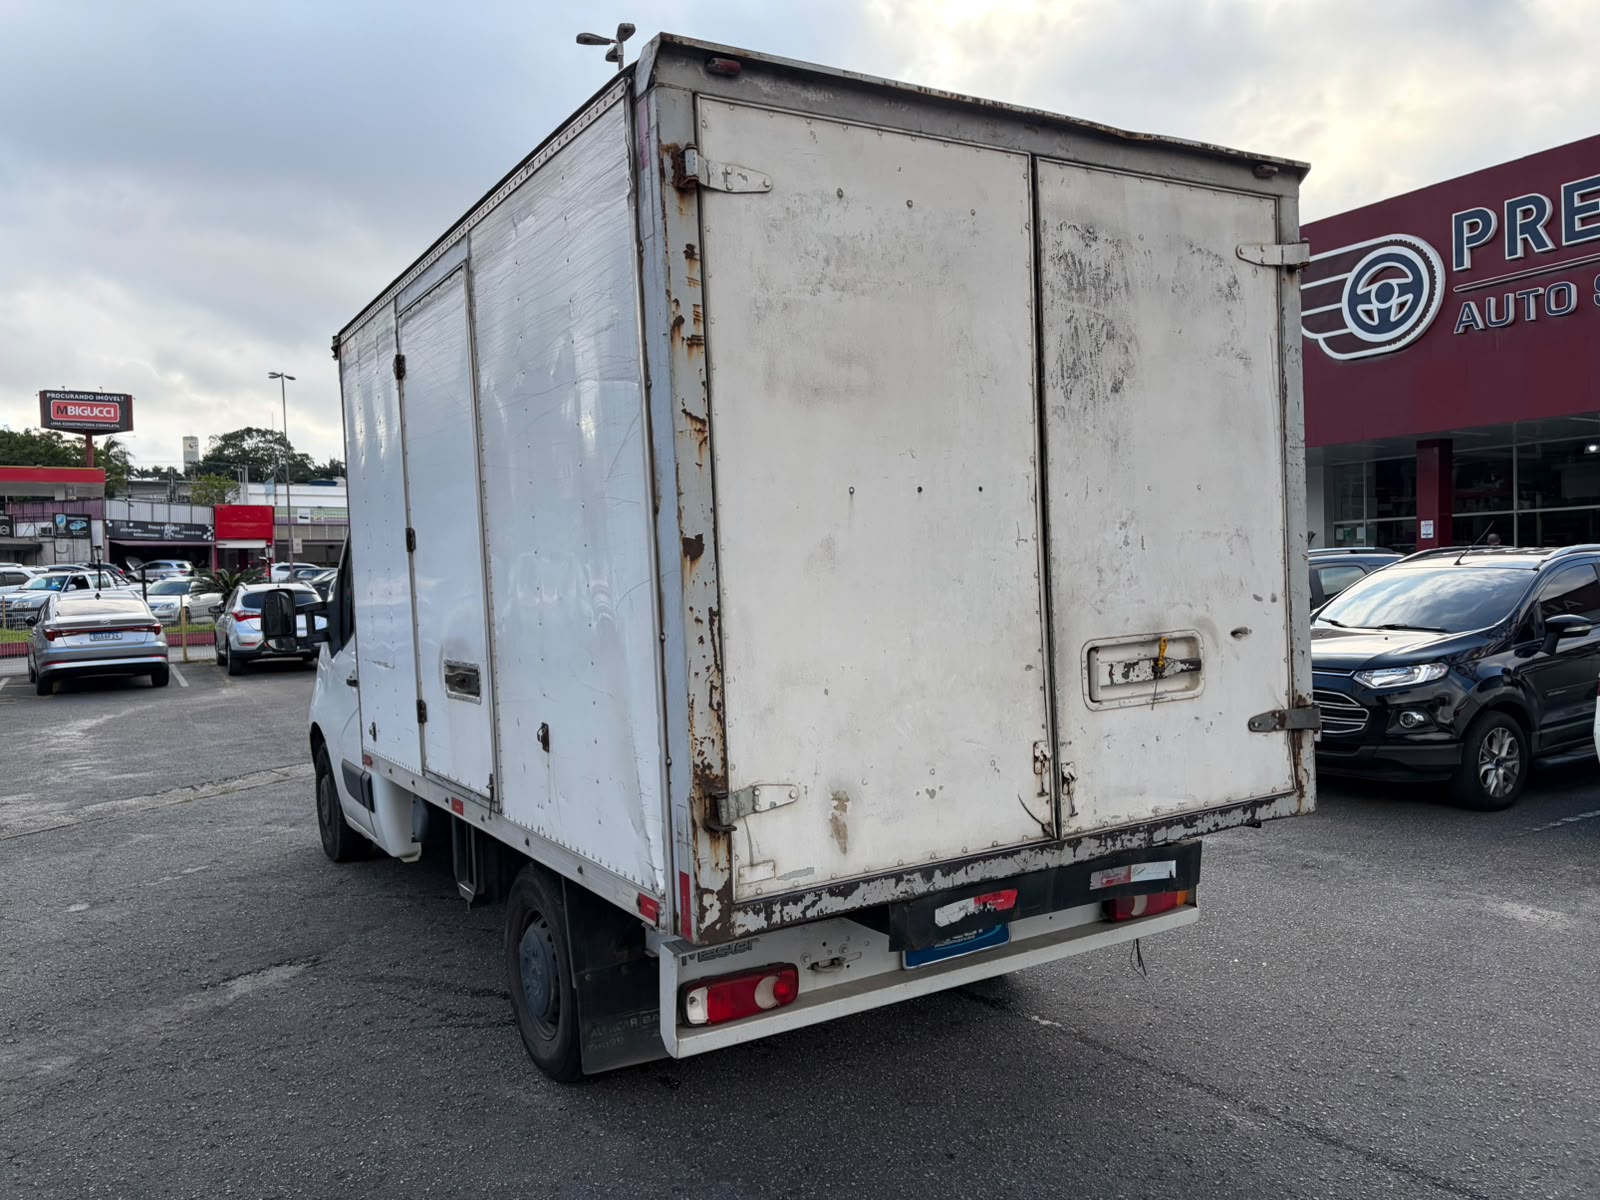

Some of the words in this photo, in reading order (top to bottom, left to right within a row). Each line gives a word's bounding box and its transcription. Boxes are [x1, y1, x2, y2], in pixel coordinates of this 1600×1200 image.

[1452, 174, 1600, 272] PRE
[1453, 281, 1577, 334] AUTO
[46, 392, 94, 401] PROCURANDO
[95, 393, 124, 402] IMÓVEL?
[56, 405, 115, 418] MBIGUCCI
